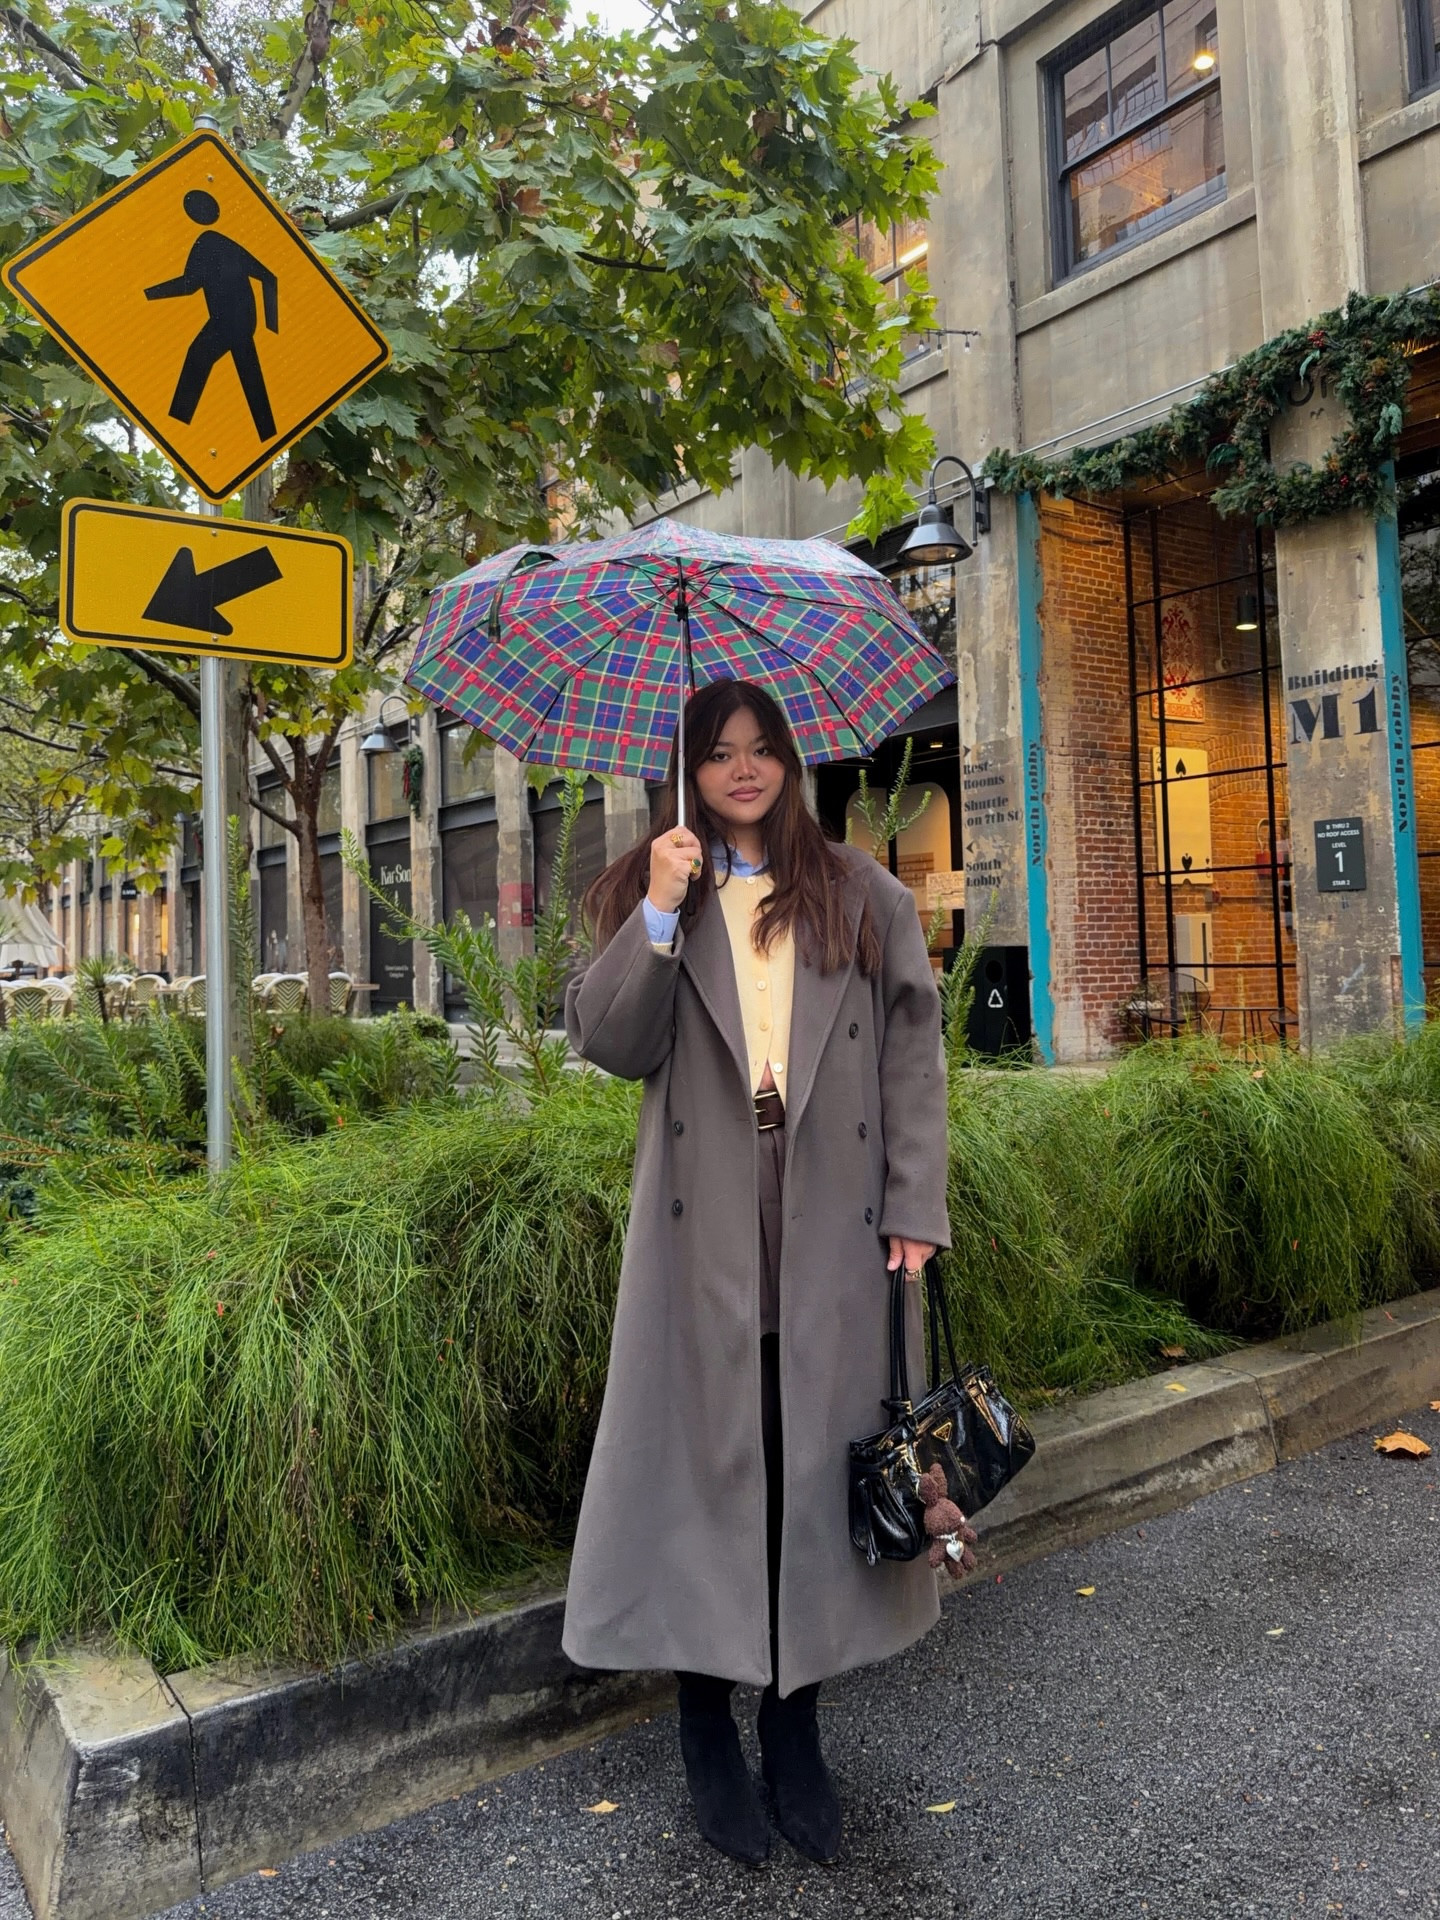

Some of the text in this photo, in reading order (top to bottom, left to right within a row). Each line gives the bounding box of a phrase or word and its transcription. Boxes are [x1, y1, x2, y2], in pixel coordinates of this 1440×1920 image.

[1288, 660, 1378, 690] Building
[1289, 685, 1384, 744] M1
[1391, 671, 1408, 833] North Lobby
[963, 775, 1005, 790] Rooms
[964, 796, 1009, 812] Shuttle
[1028, 741, 1042, 866] North Lobby
[985, 811, 1005, 824] 7th
[966, 858, 1002, 873] South
[1334, 851, 1344, 873] 1
[966, 873, 1003, 888] Lobby
